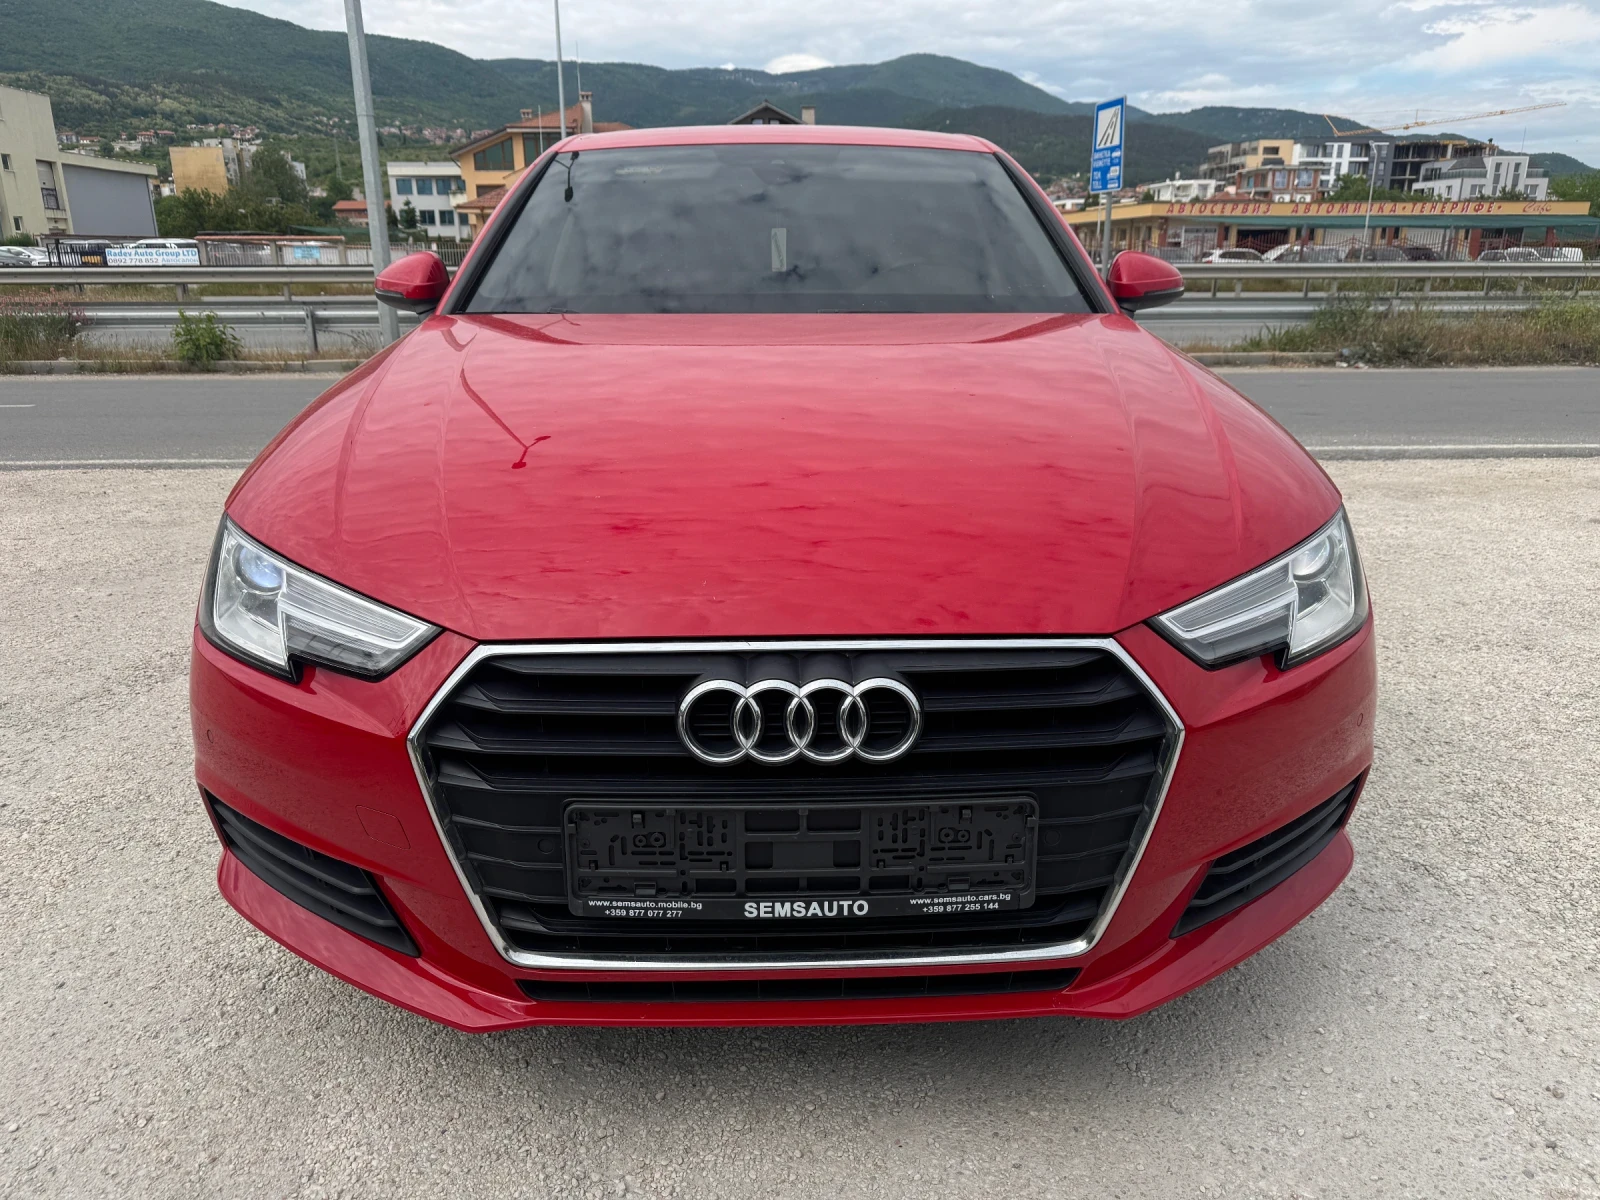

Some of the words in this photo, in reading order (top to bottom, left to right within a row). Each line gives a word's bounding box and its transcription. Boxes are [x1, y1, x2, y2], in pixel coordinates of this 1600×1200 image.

[1166, 203, 1272, 214] АВТОСЕРВИЗ
[107, 249, 132, 257] Radev
[134, 249, 154, 257] Auto
[155, 249, 181, 258] Group
[182, 249, 197, 257] LTD
[909, 893, 1011, 905] www.semsauto.cars.bg
[588, 900, 702, 910] www.semsauto.mobile.bg
[744, 900, 869, 918] SEMSAUTO
[922, 905, 944, 913] +359
[946, 904, 962, 912] 877
[964, 903, 981, 911] 255
[983, 902, 999, 910] 144
[604, 909, 626, 917] +359
[629, 909, 645, 917] 877
[666, 910, 683, 918] 277
